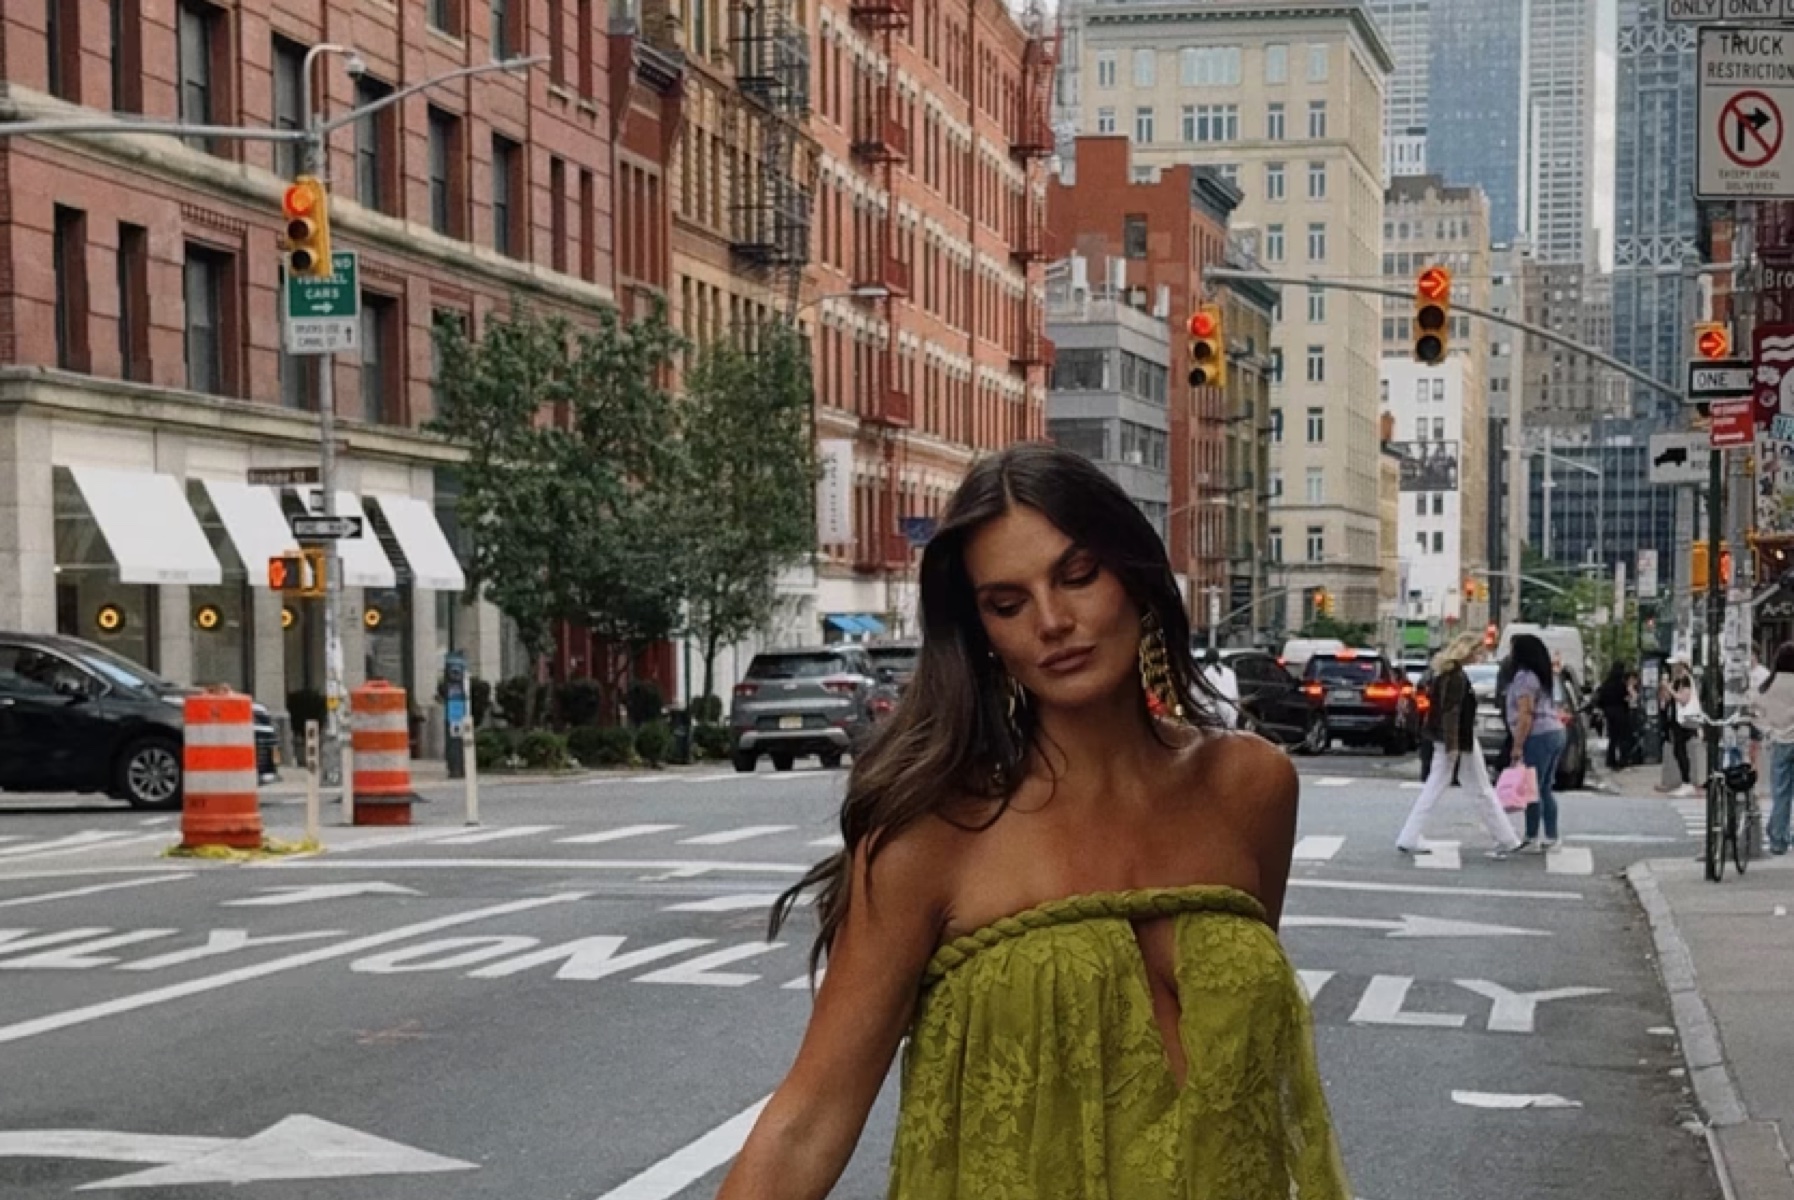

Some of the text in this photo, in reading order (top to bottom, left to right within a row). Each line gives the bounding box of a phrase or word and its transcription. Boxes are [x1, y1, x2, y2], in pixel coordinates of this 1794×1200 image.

[1671, 0, 1715, 15] ONLY
[1729, 0, 1772, 13] ONLY
[1720, 34, 1783, 56] TRUCK
[305, 287, 340, 300] CARS
[1697, 371, 1729, 389] ONE
[1297, 969, 1612, 1033] LY
